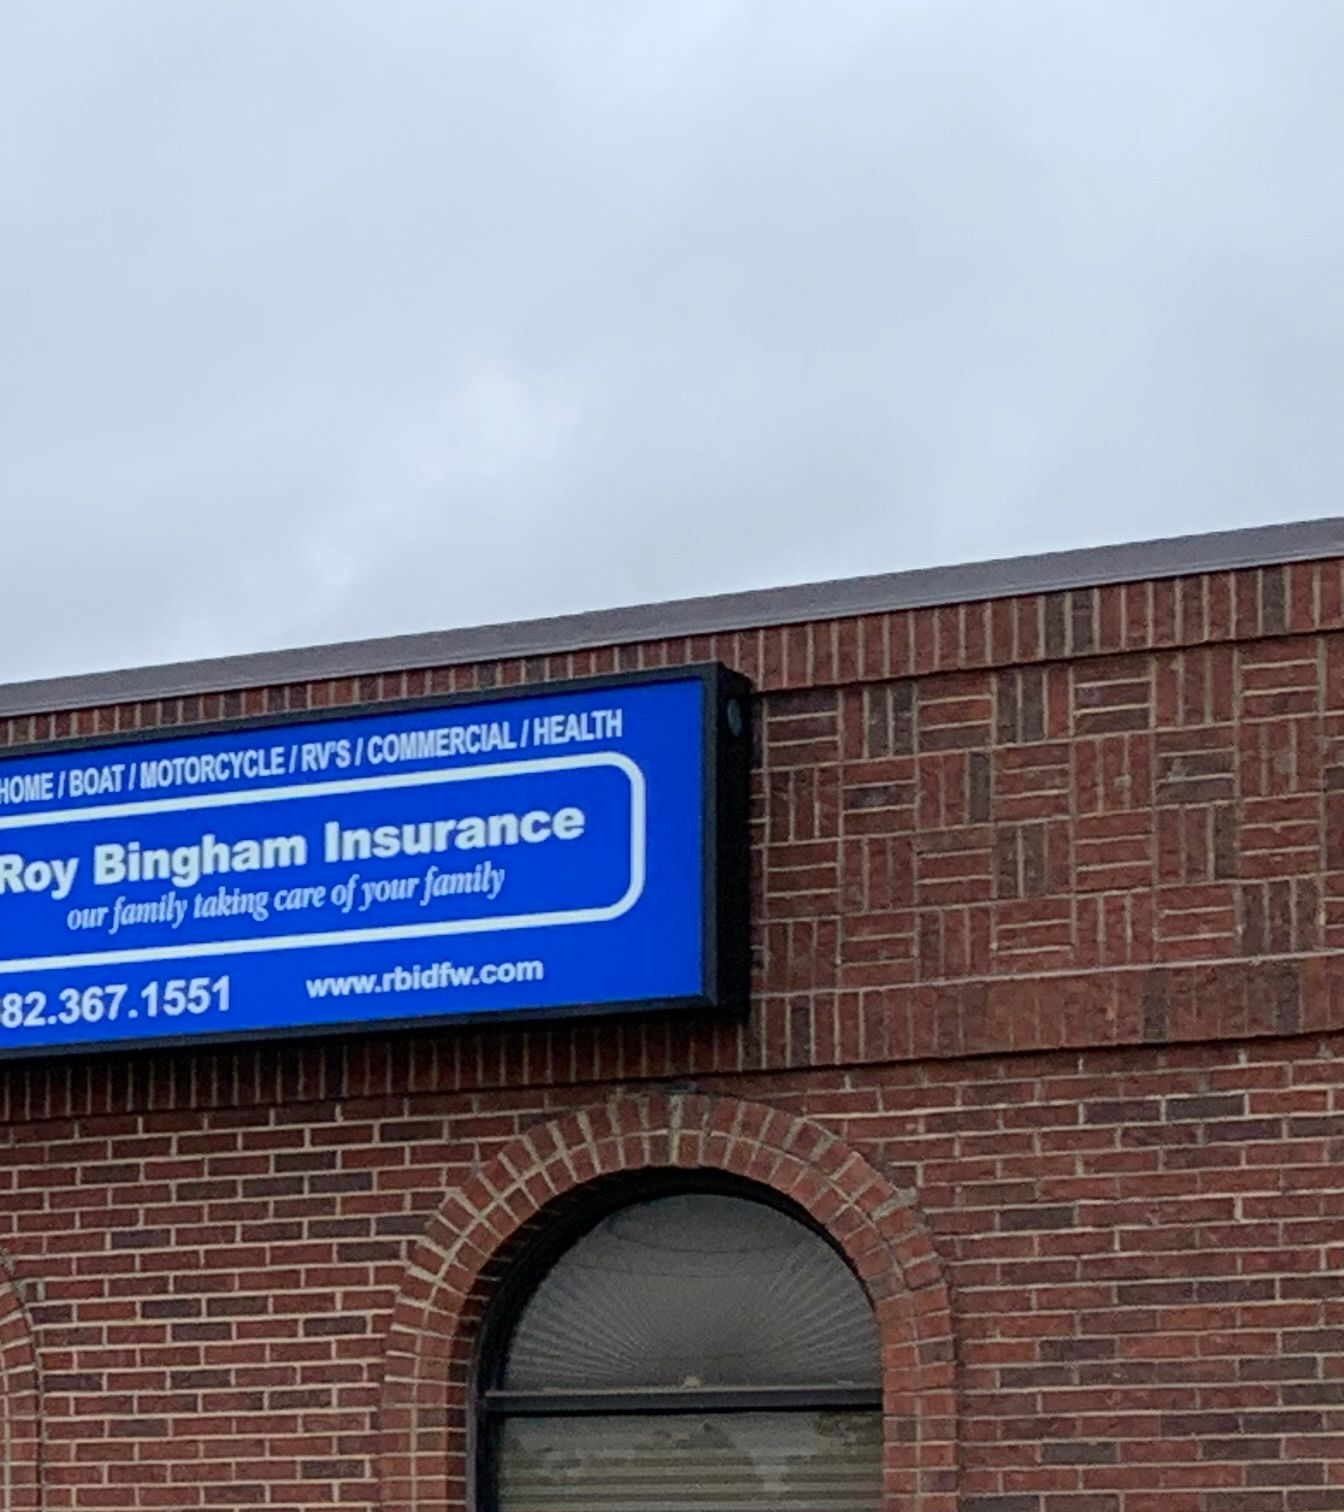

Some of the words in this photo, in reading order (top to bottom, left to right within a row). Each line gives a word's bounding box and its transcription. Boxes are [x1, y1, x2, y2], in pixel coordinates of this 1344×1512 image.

[69, 764, 125, 798] BOAT
[140, 746, 285, 789] MOTORCYCLE
[301, 739, 351, 772] RV'S
[367, 720, 517, 764] COMMERCIAL
[533, 708, 623, 747] HEALTH
[94, 833, 308, 888] Bingham
[324, 806, 585, 863] Insurance
[67, 906, 109, 931] our
[108, 891, 188, 934] family
[194, 886, 269, 921] taking
[273, 884, 326, 912] care
[330, 873, 360, 913] of
[359, 877, 419, 912] your
[420, 860, 506, 906] family
[305, 960, 544, 998] www.rbidfw.com
